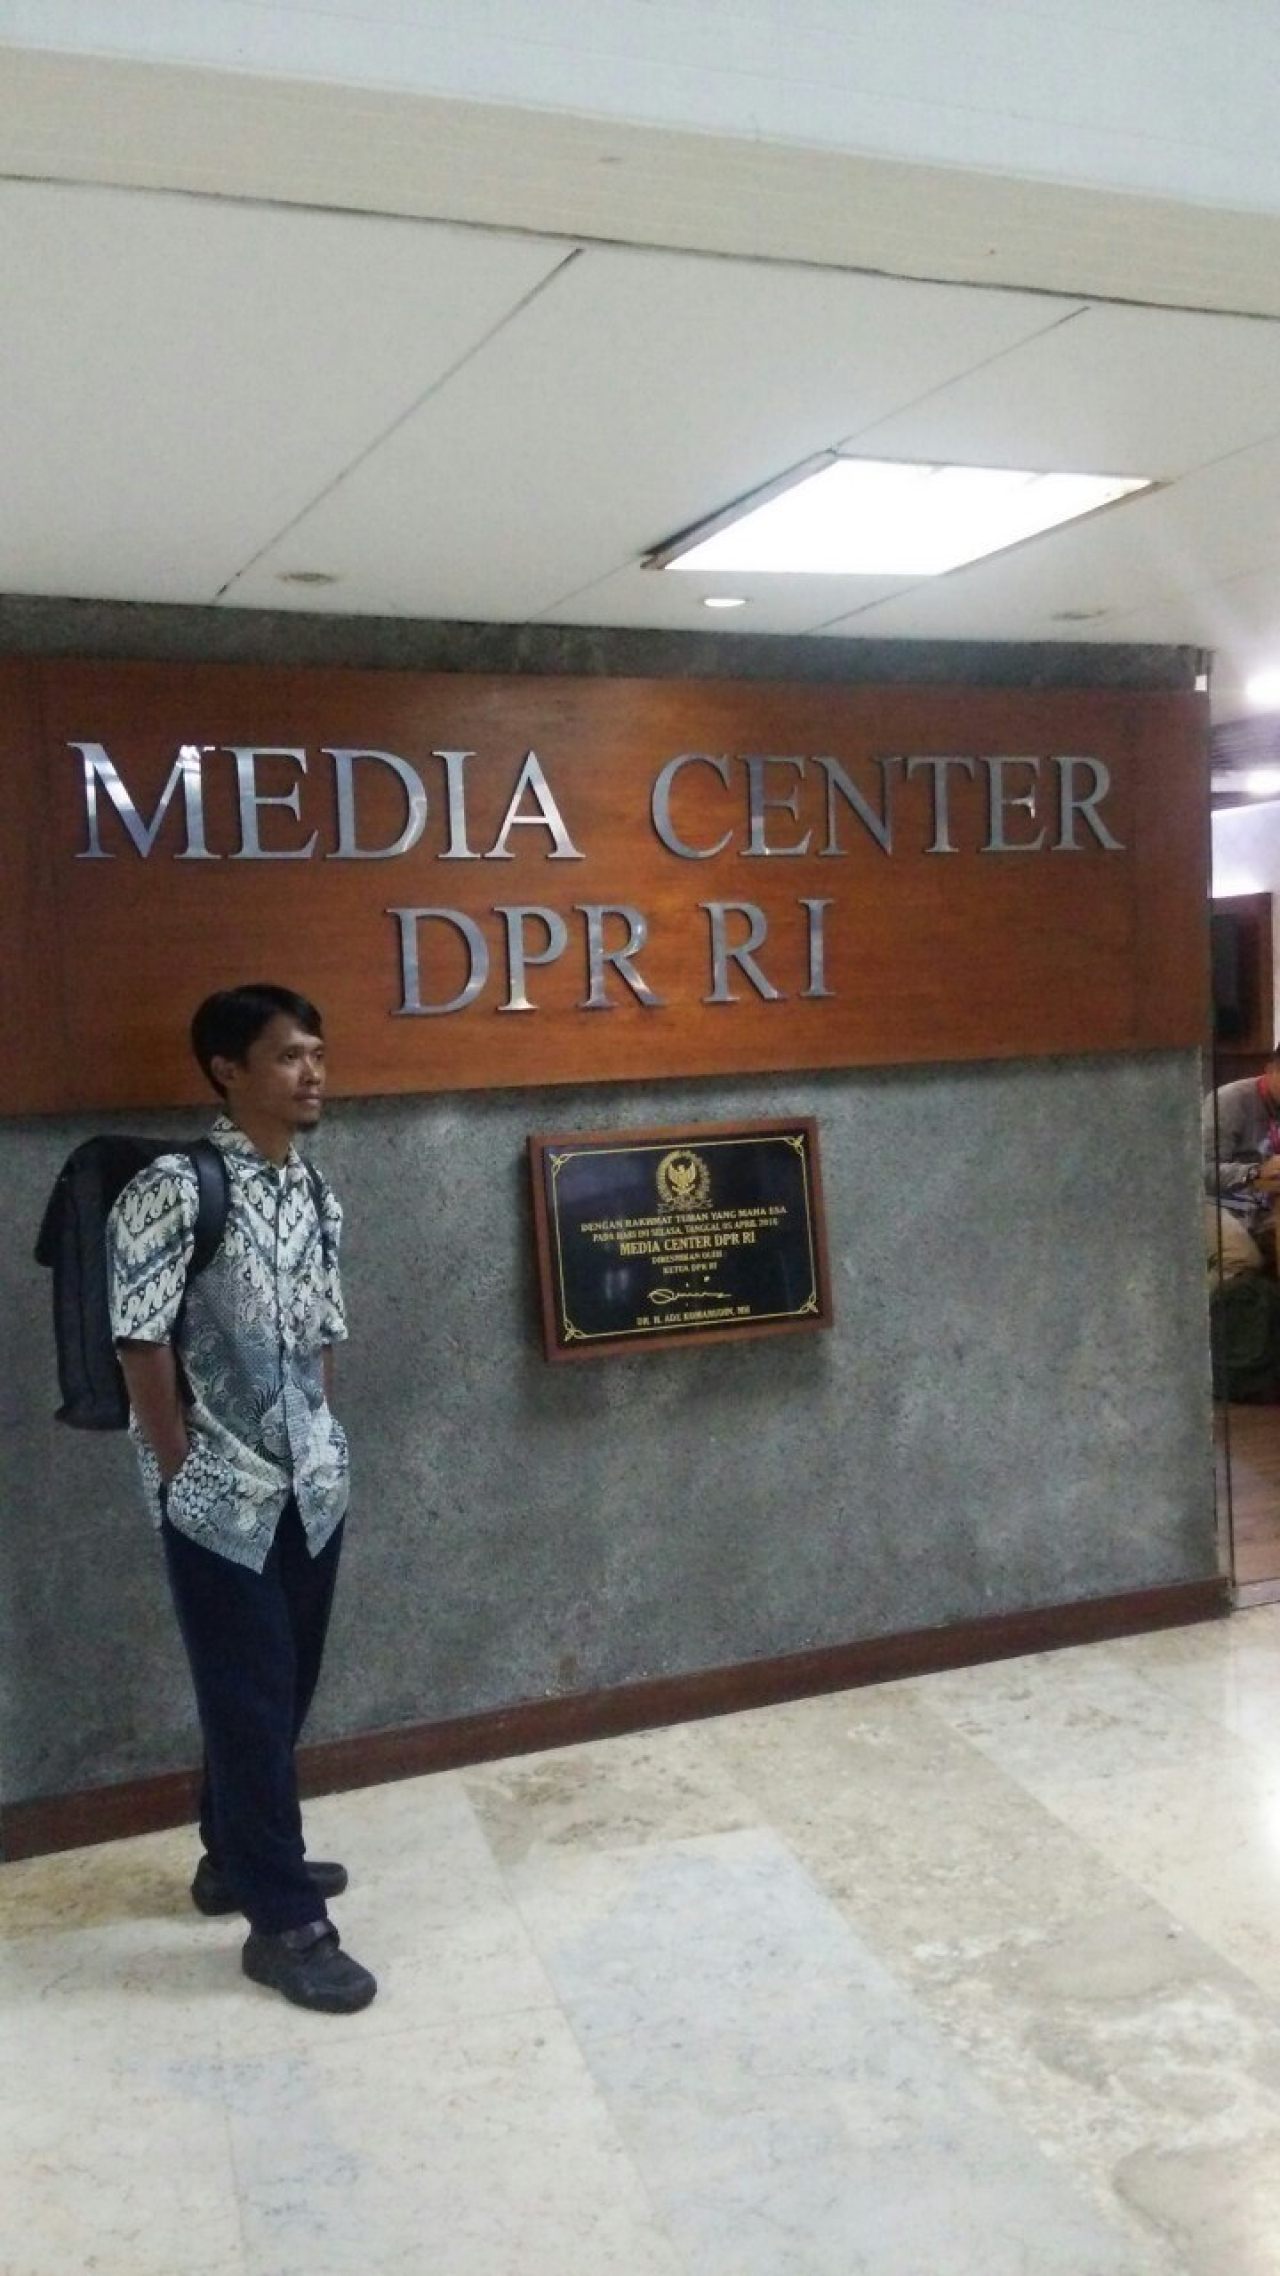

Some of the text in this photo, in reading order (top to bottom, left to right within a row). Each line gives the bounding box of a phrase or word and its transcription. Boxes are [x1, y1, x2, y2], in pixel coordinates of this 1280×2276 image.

[67, 742, 1125, 859] MEDIA CENTER
[388, 898, 835, 1016] DPR RI
[581, 1221, 623, 1232] DENGAN
[676, 1213, 709, 1223] TUHAN
[711, 1210, 737, 1219] YANG
[738, 1207, 767, 1217] MAHA
[769, 1205, 788, 1215] ESA
[593, 1231, 615, 1242] PADA
[616, 1229, 637, 1240] HARI
[685, 1223, 721, 1233] TANGGAL
[735, 1219, 757, 1228] APRIL
[620, 1230, 756, 1256] MEDIA CENTER DPR RI
[652, 1249, 723, 1264] DIRESMIKAN OLEH
[691, 1262, 709, 1272] DPR
